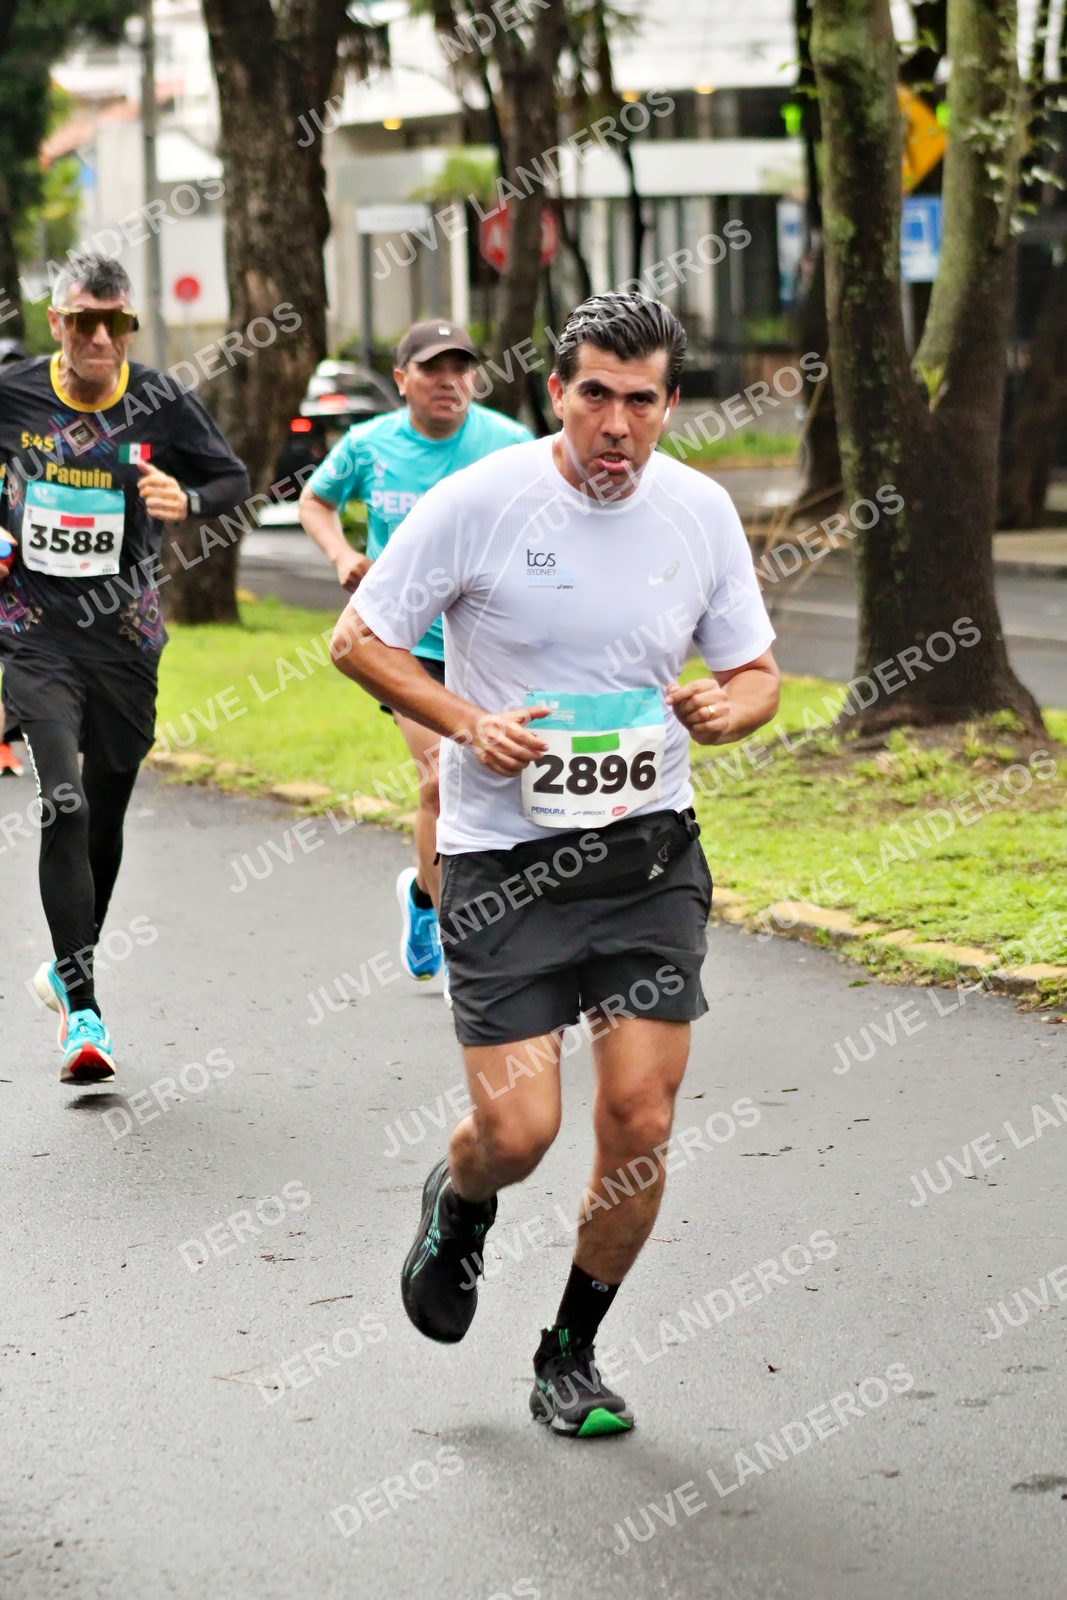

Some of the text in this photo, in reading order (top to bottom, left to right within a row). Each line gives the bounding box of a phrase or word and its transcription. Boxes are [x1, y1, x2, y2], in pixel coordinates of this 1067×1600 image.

[45, 462, 113, 488] Paquin
[29, 523, 115, 555] 3588
[526, 548, 557, 567] tcs
[526, 568, 557, 577] SYDNEY
[532, 750, 656, 796] 2896
[530, 806, 566, 816] PERDURA
